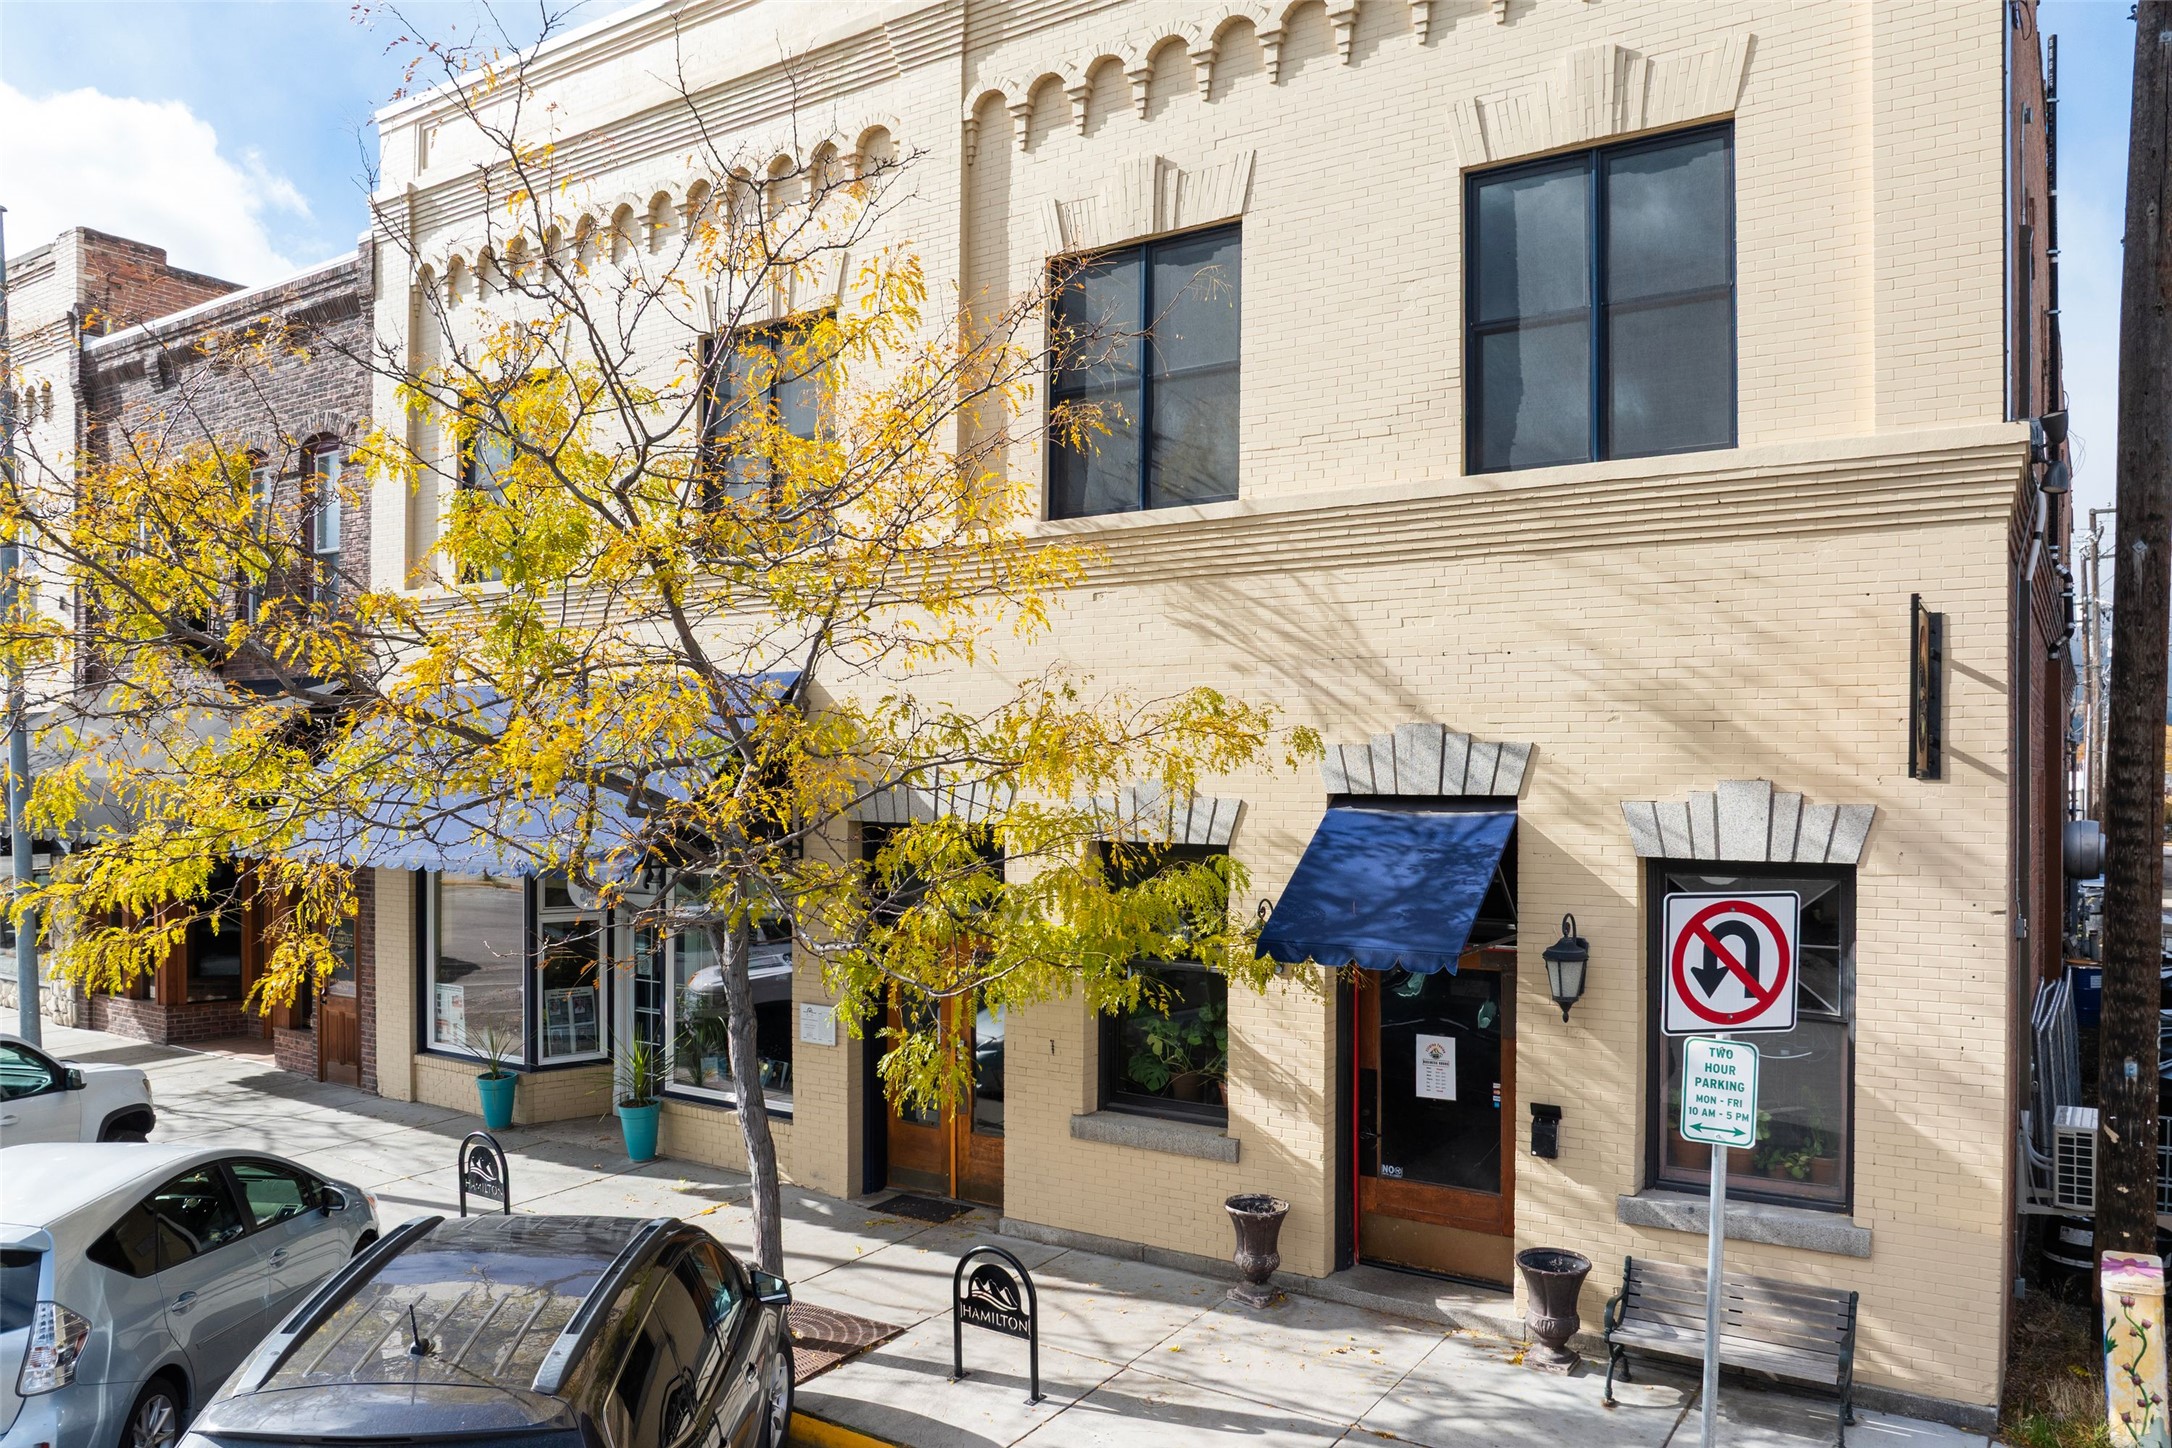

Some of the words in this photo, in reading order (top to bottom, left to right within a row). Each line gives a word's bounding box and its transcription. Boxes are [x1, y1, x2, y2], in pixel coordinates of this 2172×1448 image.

[1709, 1047, 1734, 1060] TWO
[1704, 1062, 1736, 1076] HOUR
[1695, 1077, 1745, 1093] PARKING
[1695, 1094, 1717, 1105] MON
[1727, 1097, 1743, 1108] FRI
[1688, 1106, 1698, 1115] 10
[1700, 1107, 1716, 1118] AM
[1726, 1110, 1732, 1120] 5
[1735, 1111, 1750, 1123] PM
[465, 1178, 503, 1196] HAMILTON
[963, 1305, 1028, 1332] HAMILTON
